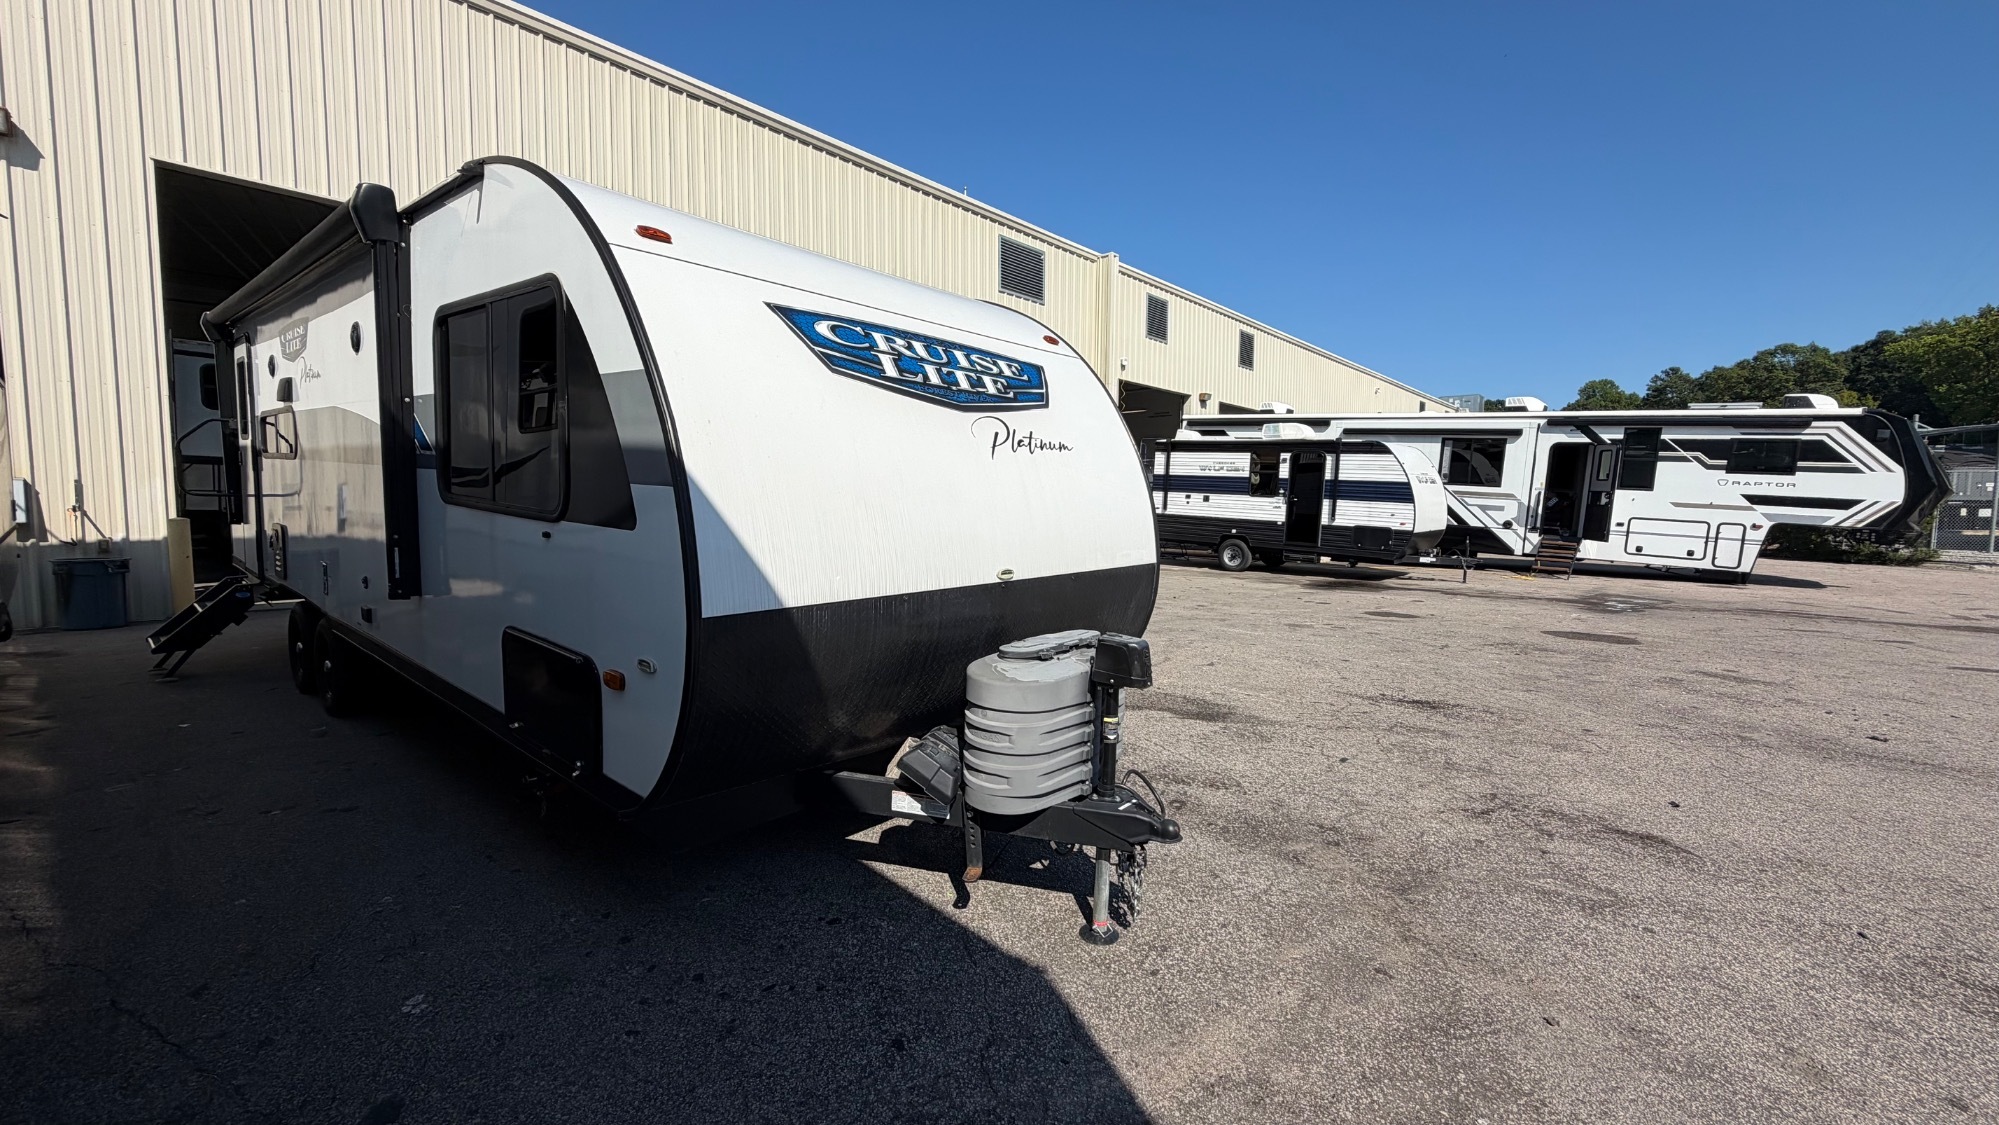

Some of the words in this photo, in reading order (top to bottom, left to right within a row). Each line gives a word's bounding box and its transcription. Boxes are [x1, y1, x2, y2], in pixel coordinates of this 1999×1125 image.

[281, 325, 305, 342] CRUISE
[286, 337, 302, 353] LITE
[813, 320, 1029, 381] CRUISE
[871, 351, 1015, 398] LITE
[971, 416, 1074, 460] Platinum
